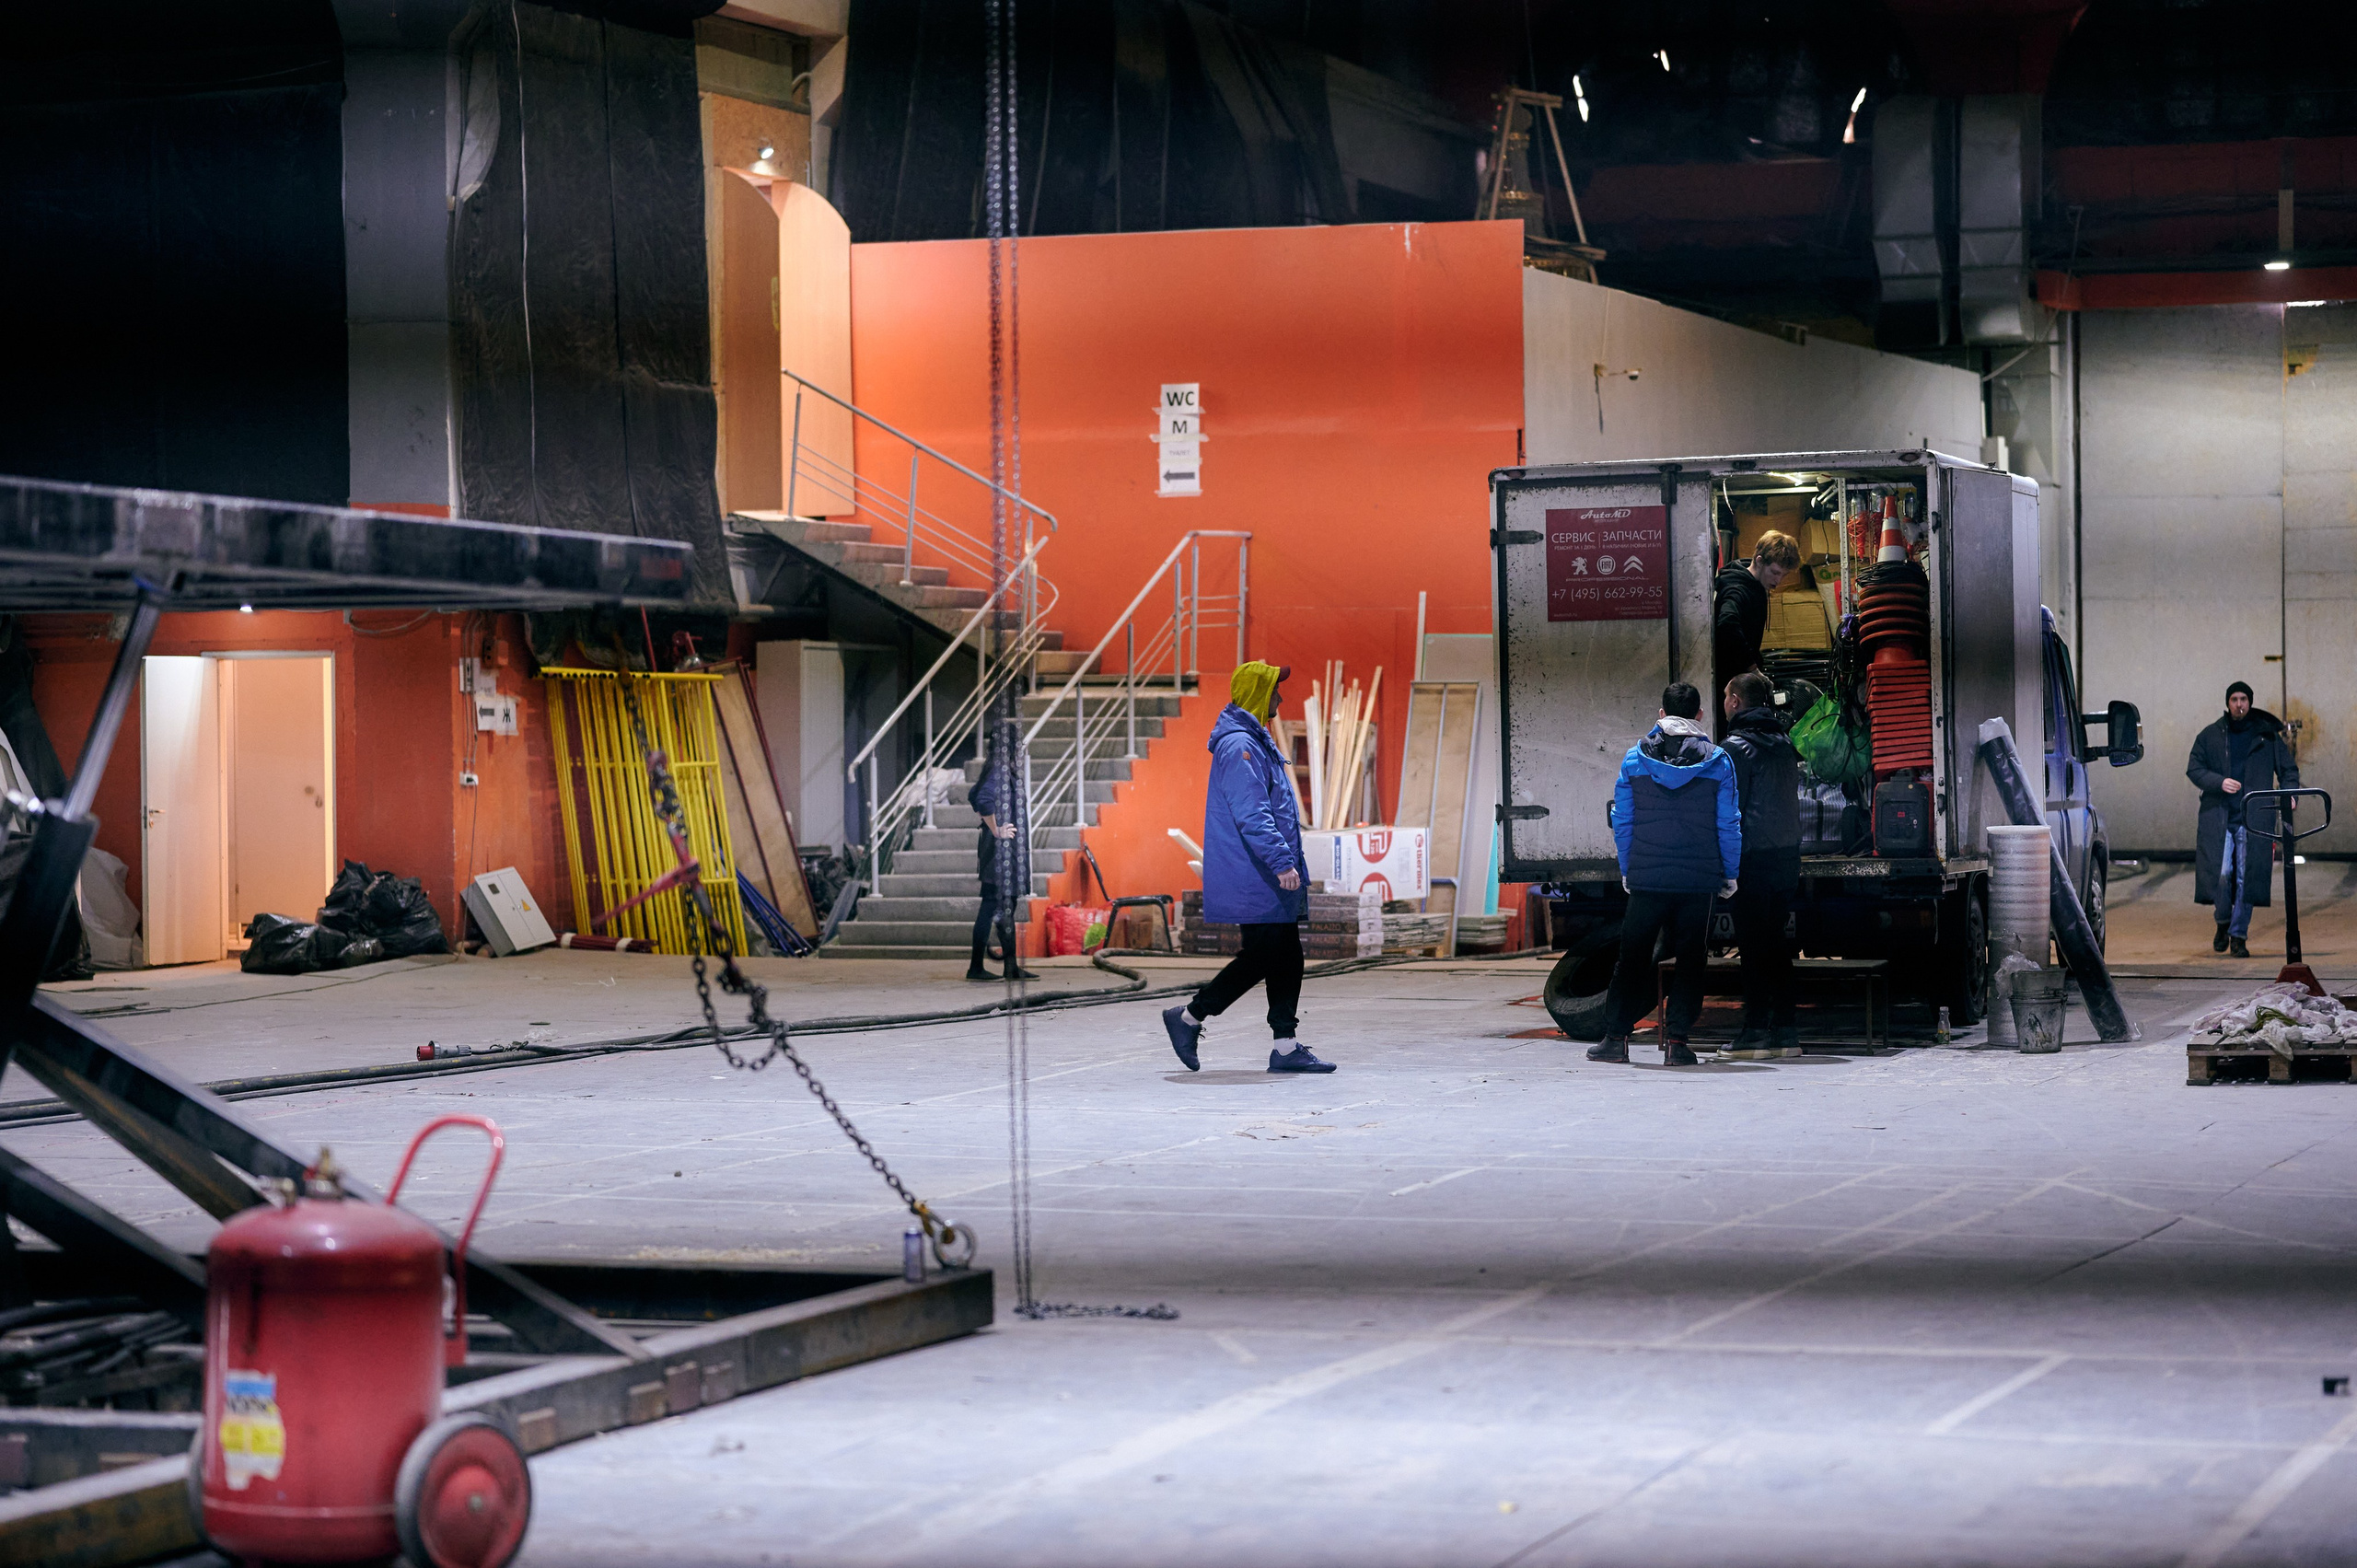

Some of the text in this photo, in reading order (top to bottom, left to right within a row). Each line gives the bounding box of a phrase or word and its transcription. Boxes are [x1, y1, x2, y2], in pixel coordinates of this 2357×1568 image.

[1166, 391, 1194, 407] WC
[1580, 508, 1631, 519] AutoMD
[1551, 529, 1662, 543] СЕРВИС ЗАПЧАСТИ
[1551, 586, 1663, 602] +7 (495) 662-99-55
[502, 707, 511, 723] Ж
